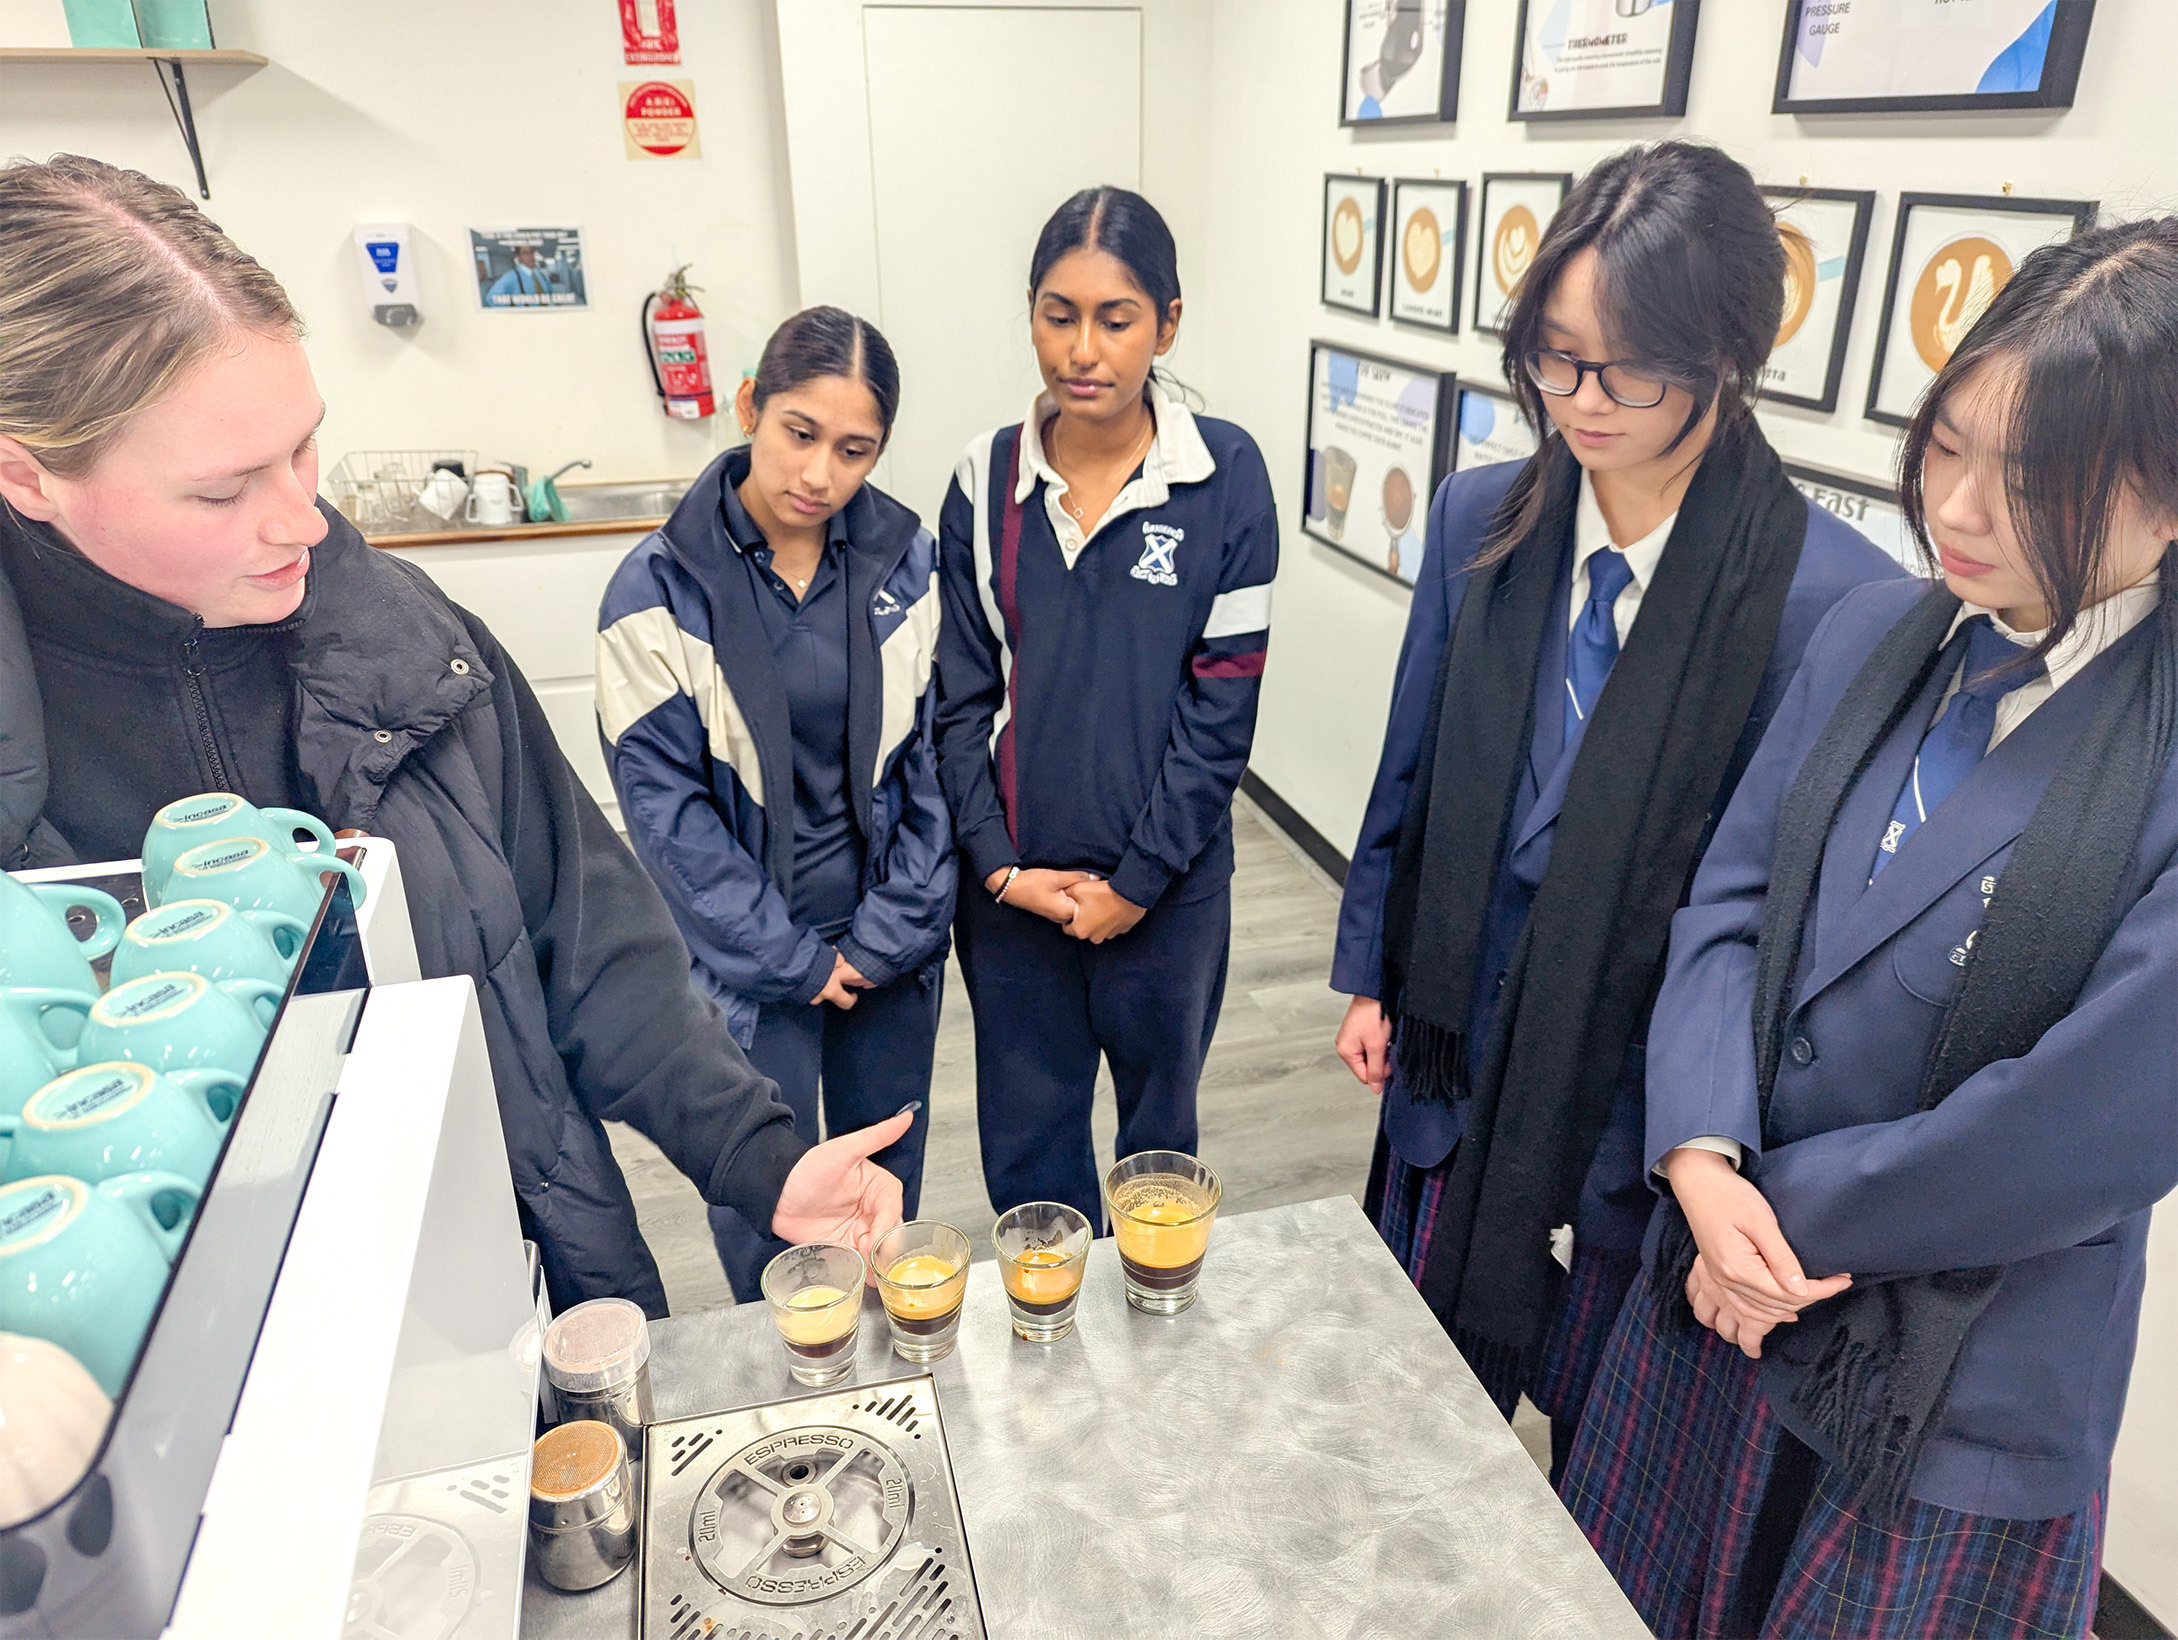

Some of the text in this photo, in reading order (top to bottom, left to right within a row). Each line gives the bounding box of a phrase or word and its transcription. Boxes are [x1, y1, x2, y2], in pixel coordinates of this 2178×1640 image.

[1805, 2, 1850, 16] PRESSURE
[1809, 22, 1840, 36] GAUGE
[1567, 33, 1627, 49] THERMOMETER
[184, 804, 227, 820] incasa
[203, 849, 249, 867] incasa
[743, 1434, 855, 1466] ESPRESSO
[744, 1556, 867, 1594] ESPRESSO
